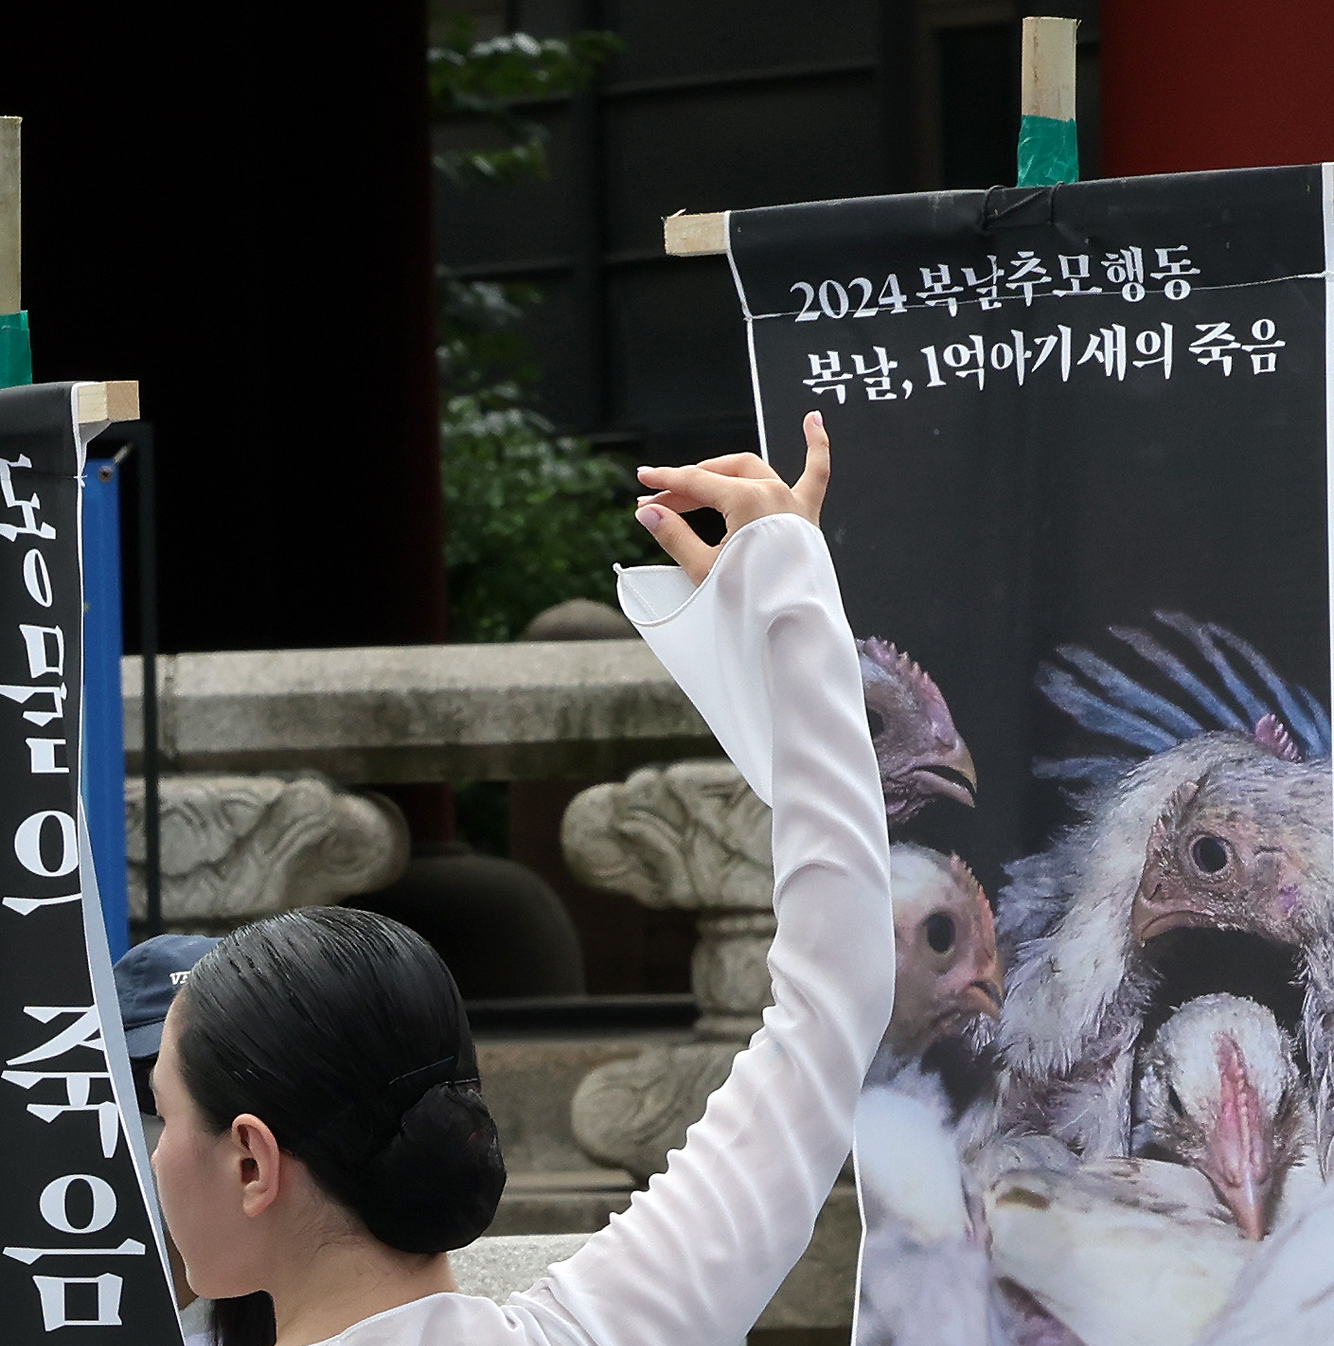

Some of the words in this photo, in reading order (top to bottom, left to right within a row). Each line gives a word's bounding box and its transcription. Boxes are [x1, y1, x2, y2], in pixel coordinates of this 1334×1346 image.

[789, 272, 909, 324] 2024
[915, 243, 1202, 318] 복날추모행동
[801, 346, 915, 405] 복날,
[919, 321, 1175, 393] 1억아기새의
[1186, 316, 1287, 379] 죽음
